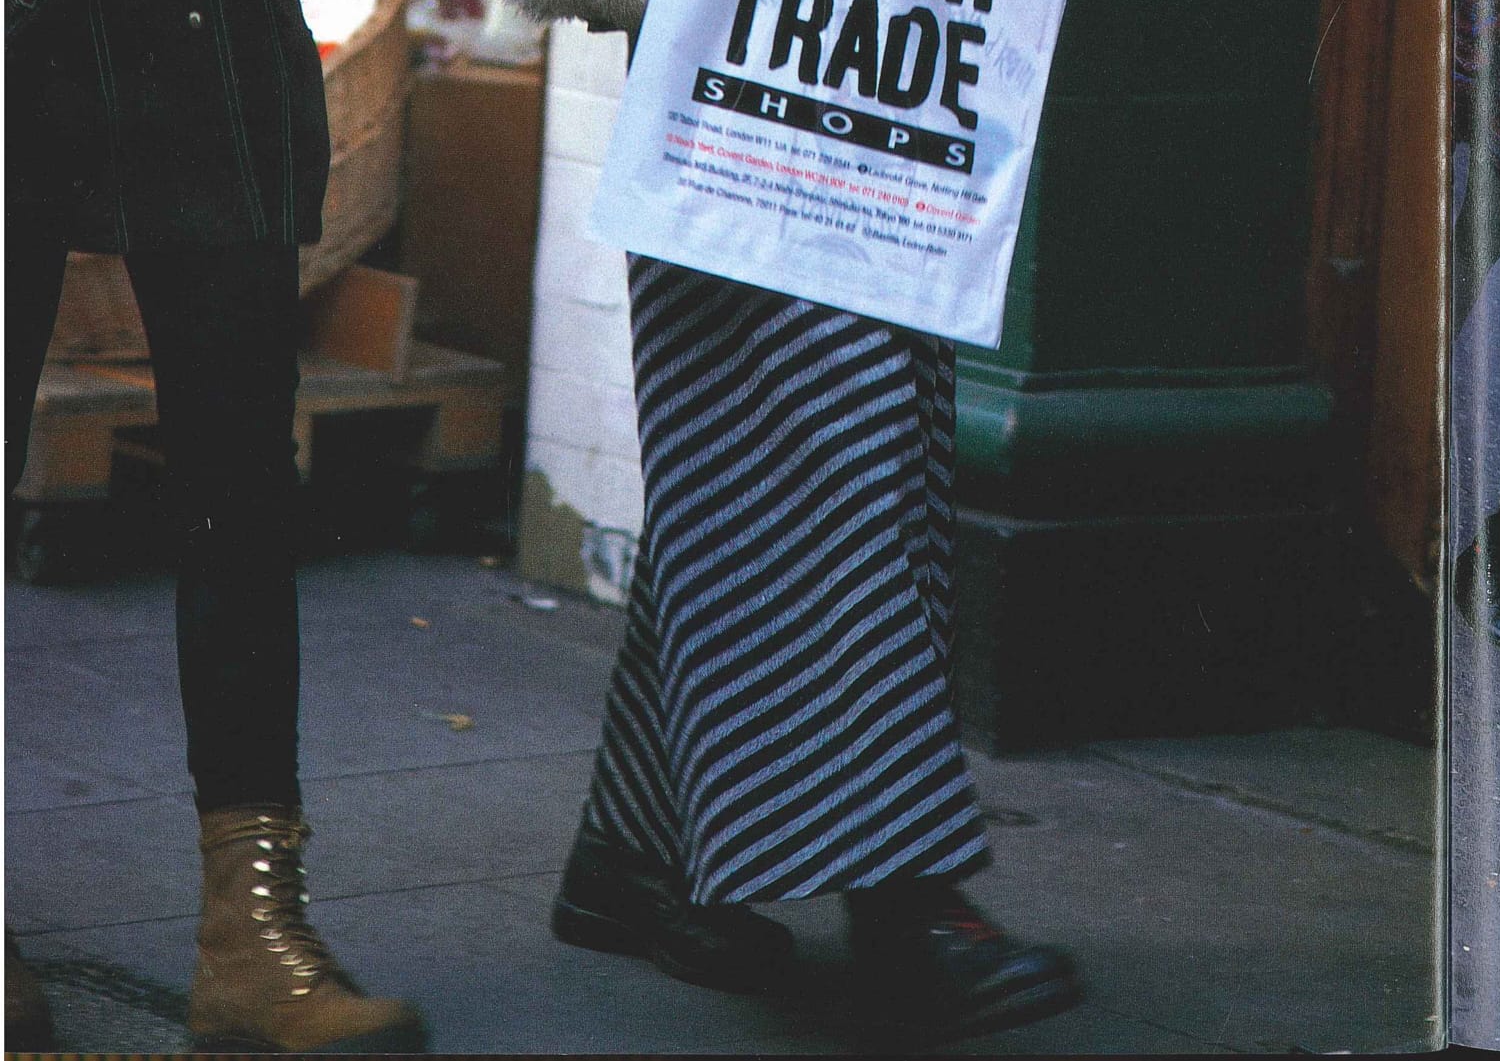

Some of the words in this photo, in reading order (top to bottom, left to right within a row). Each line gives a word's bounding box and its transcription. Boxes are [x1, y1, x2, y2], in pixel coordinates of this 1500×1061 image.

[703, 76, 966, 168] SHOPS
[726, 127, 754, 142] London
[931, 181, 959, 199] Notting
